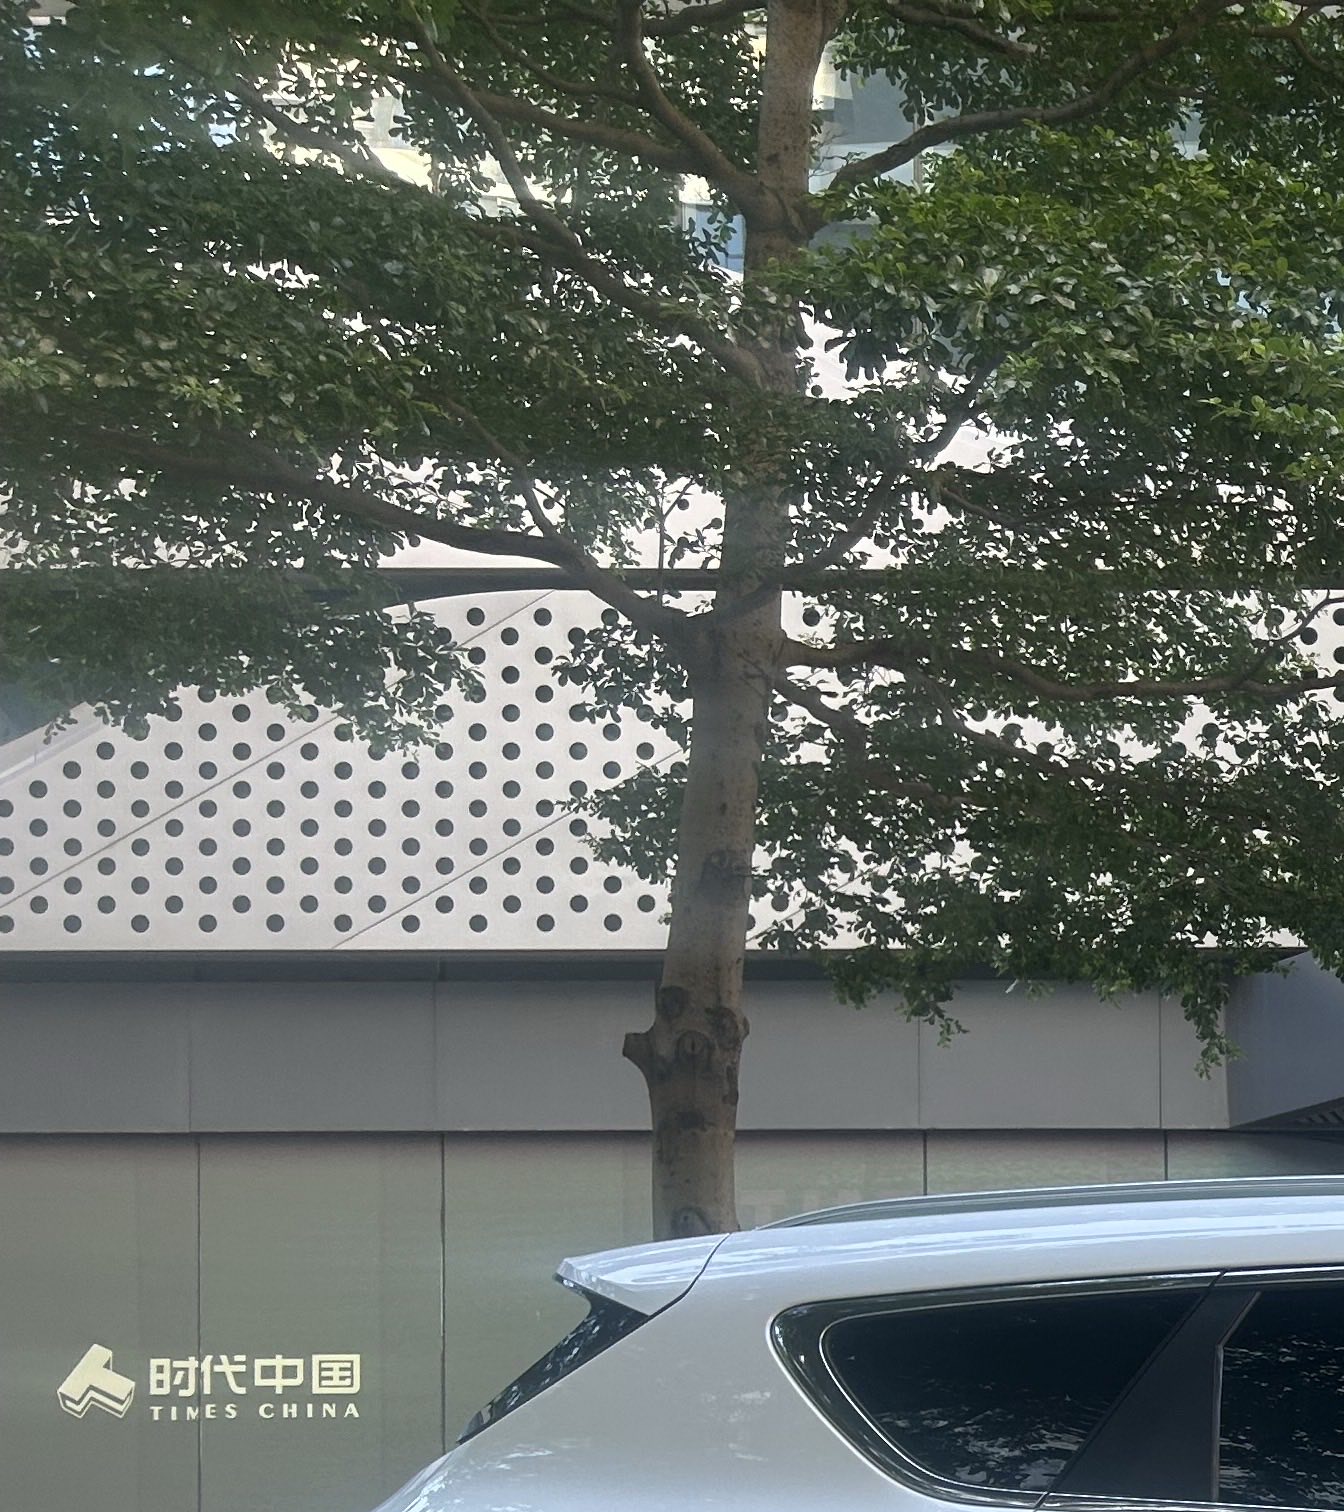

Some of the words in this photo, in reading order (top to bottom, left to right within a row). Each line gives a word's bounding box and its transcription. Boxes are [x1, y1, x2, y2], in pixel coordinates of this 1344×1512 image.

[150, 1354, 361, 1397] 时代中国
[151, 1403, 238, 1421] TIMES
[259, 1402, 360, 1419] CHINA
